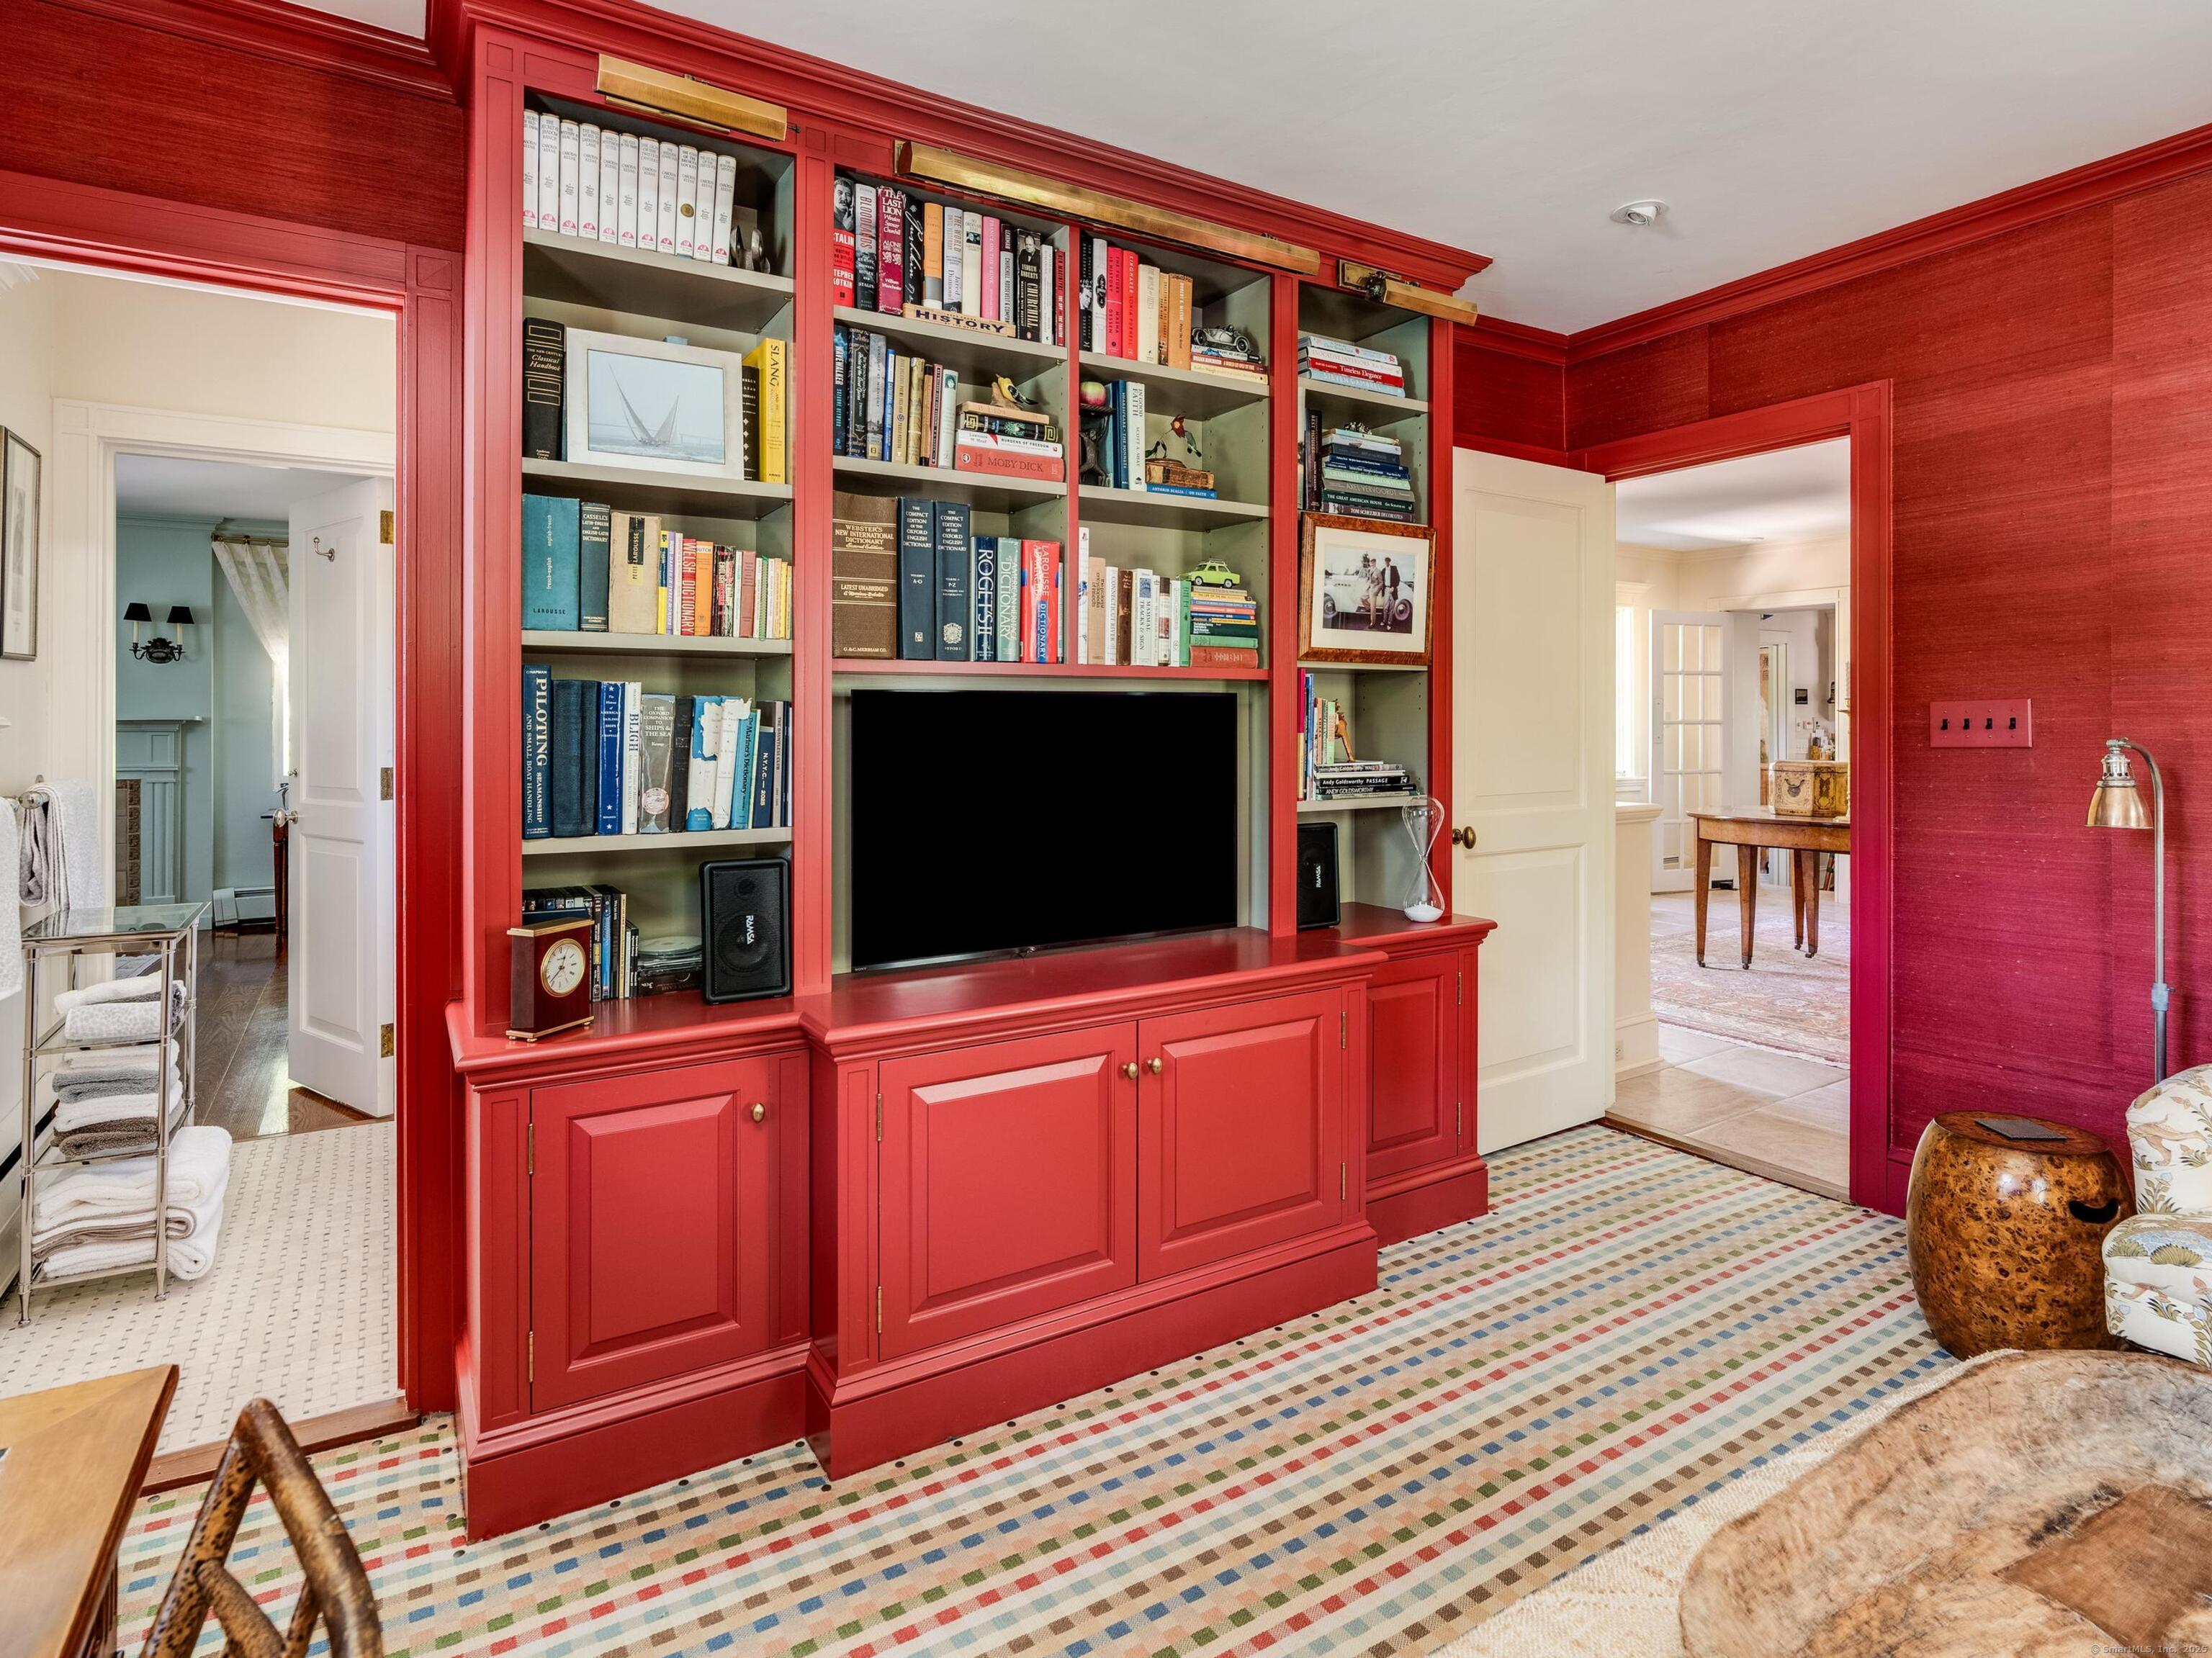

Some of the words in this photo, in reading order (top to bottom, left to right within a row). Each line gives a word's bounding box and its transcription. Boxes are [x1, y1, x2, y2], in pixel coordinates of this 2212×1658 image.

[882, 197, 902, 209] LAST
[884, 189, 902, 199] THE
[882, 205, 902, 216] LION
[884, 214, 901, 222] Winston
[860, 196, 872, 249] BLOODLANDS
[884, 227, 901, 235] Churchill
[885, 220, 899, 229] Spencer
[834, 233, 855, 245] TALIN
[905, 210, 923, 279] Pushkin
[953, 230, 962, 252] WORLD
[1020, 270, 1038, 279] ROBERTS
[1022, 263, 1037, 272] ANDREW
[1027, 282, 1038, 328] CHURCHILL
[916, 310, 1004, 333] HISTORY
[530, 361, 561, 371] Handbook
[531, 354, 559, 364] Classical
[770, 345, 779, 387] SLANG
[835, 346, 844, 385] WAVEWALKER
[1325, 372, 1349, 383] STEVEN
[1339, 365, 1361, 375] Timeless
[1362, 370, 1382, 379] Elegance
[987, 457, 1018, 468] MOBY
[1020, 461, 1043, 472] DICK
[1362, 485, 1396, 496] VERVOORDT
[683, 541, 696, 573] WELSH
[978, 549, 994, 623] ROGET'S
[681, 580, 696, 636] DICTIONARY
[1000, 562, 1011, 639] DICTIONARY
[978, 626, 992, 636] II
[536, 677, 548, 767] PILOTING
[629, 713, 639, 752] BLIGH
[745, 725, 753, 757] Mariner's
[741, 759, 750, 796] Dictionary
[746, 915, 755, 945] RAMSA
